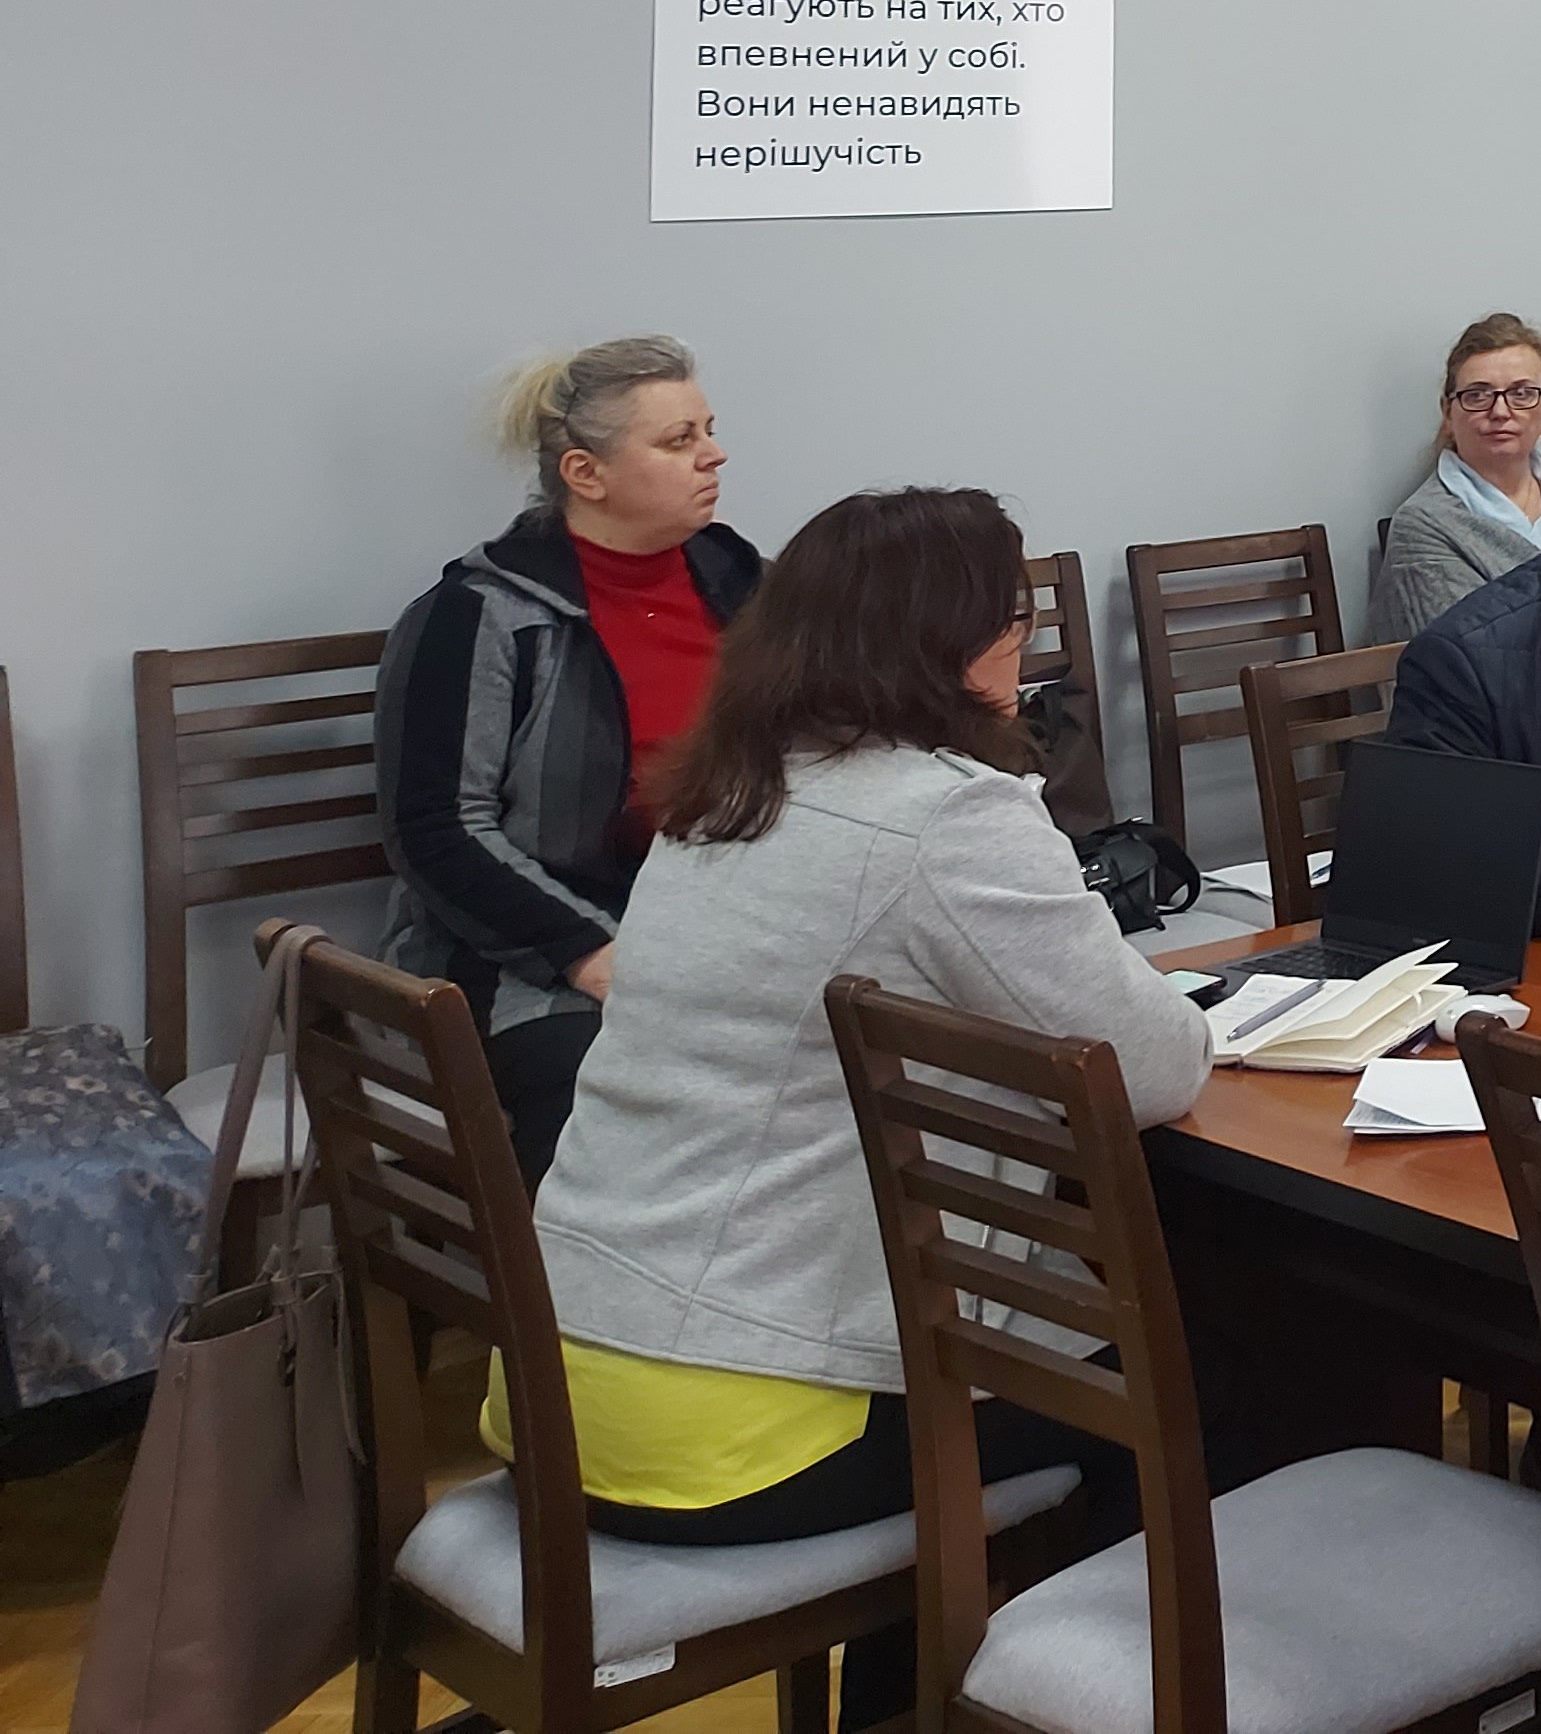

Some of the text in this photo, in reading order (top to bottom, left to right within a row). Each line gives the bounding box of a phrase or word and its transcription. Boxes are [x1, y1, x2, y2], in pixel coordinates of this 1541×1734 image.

[937, 0, 1002, 26] тих,
[1012, 2, 1064, 23] хто
[698, 41, 1026, 74] впевнений у собі.
[699, 90, 1021, 120] Вони ненавидять
[696, 138, 922, 173] нерішучість
